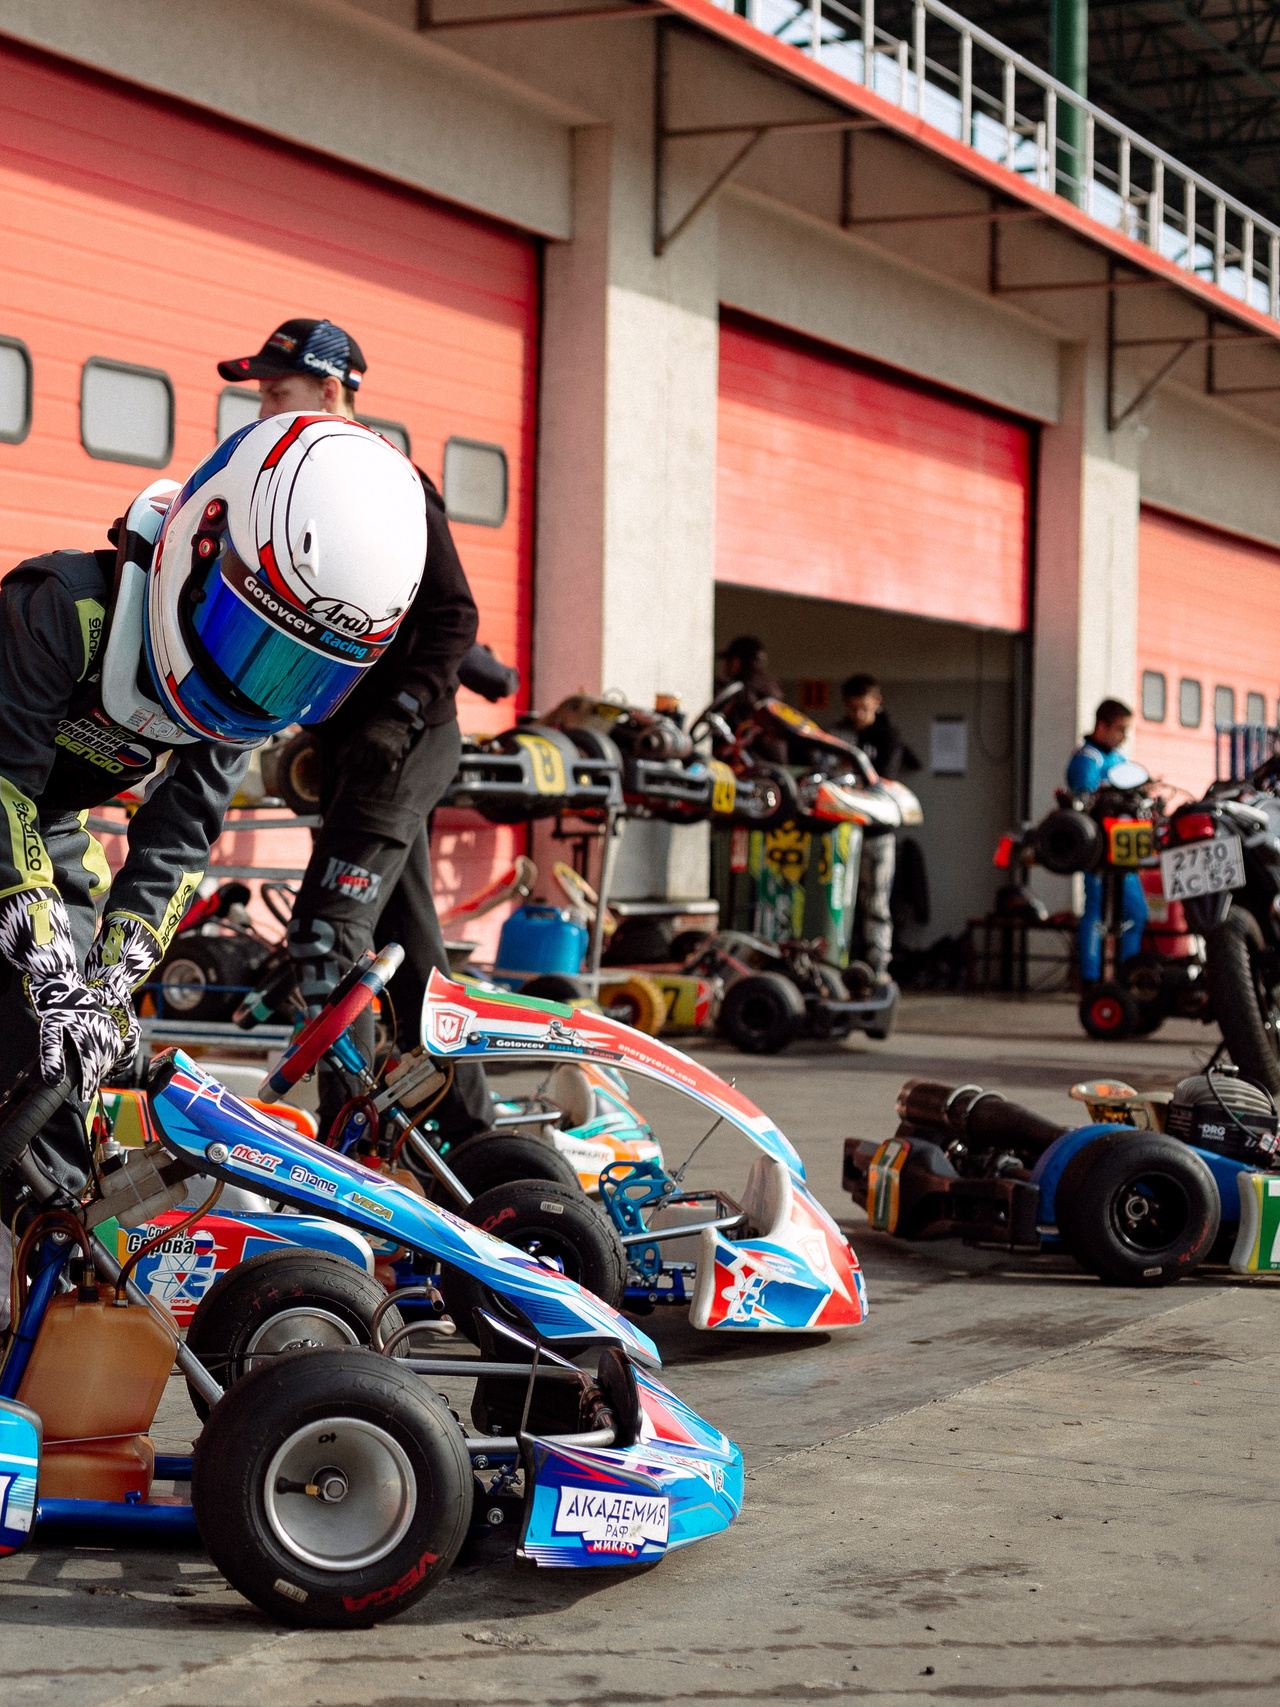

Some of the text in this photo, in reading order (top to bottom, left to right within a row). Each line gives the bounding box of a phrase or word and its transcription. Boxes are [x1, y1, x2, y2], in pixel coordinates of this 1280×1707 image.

[244, 575, 316, 634] Gotovcev
[319, 630, 368, 659] Racing
[319, 603, 370, 633] Arai
[54, 733, 125, 774] BENGIO
[496, 1040, 544, 1050] Gotovcev
[588, 1049, 615, 1059] Team
[618, 1042, 697, 1087] energycorse.com
[351, 1193, 393, 1219] VEGA
[567, 1494, 666, 1526] АКАДЕМИЯ
[605, 1523, 629, 1538] РАФ
[593, 1540, 635, 1554] МИКРО
[343, 1550, 438, 1612] VEGA
